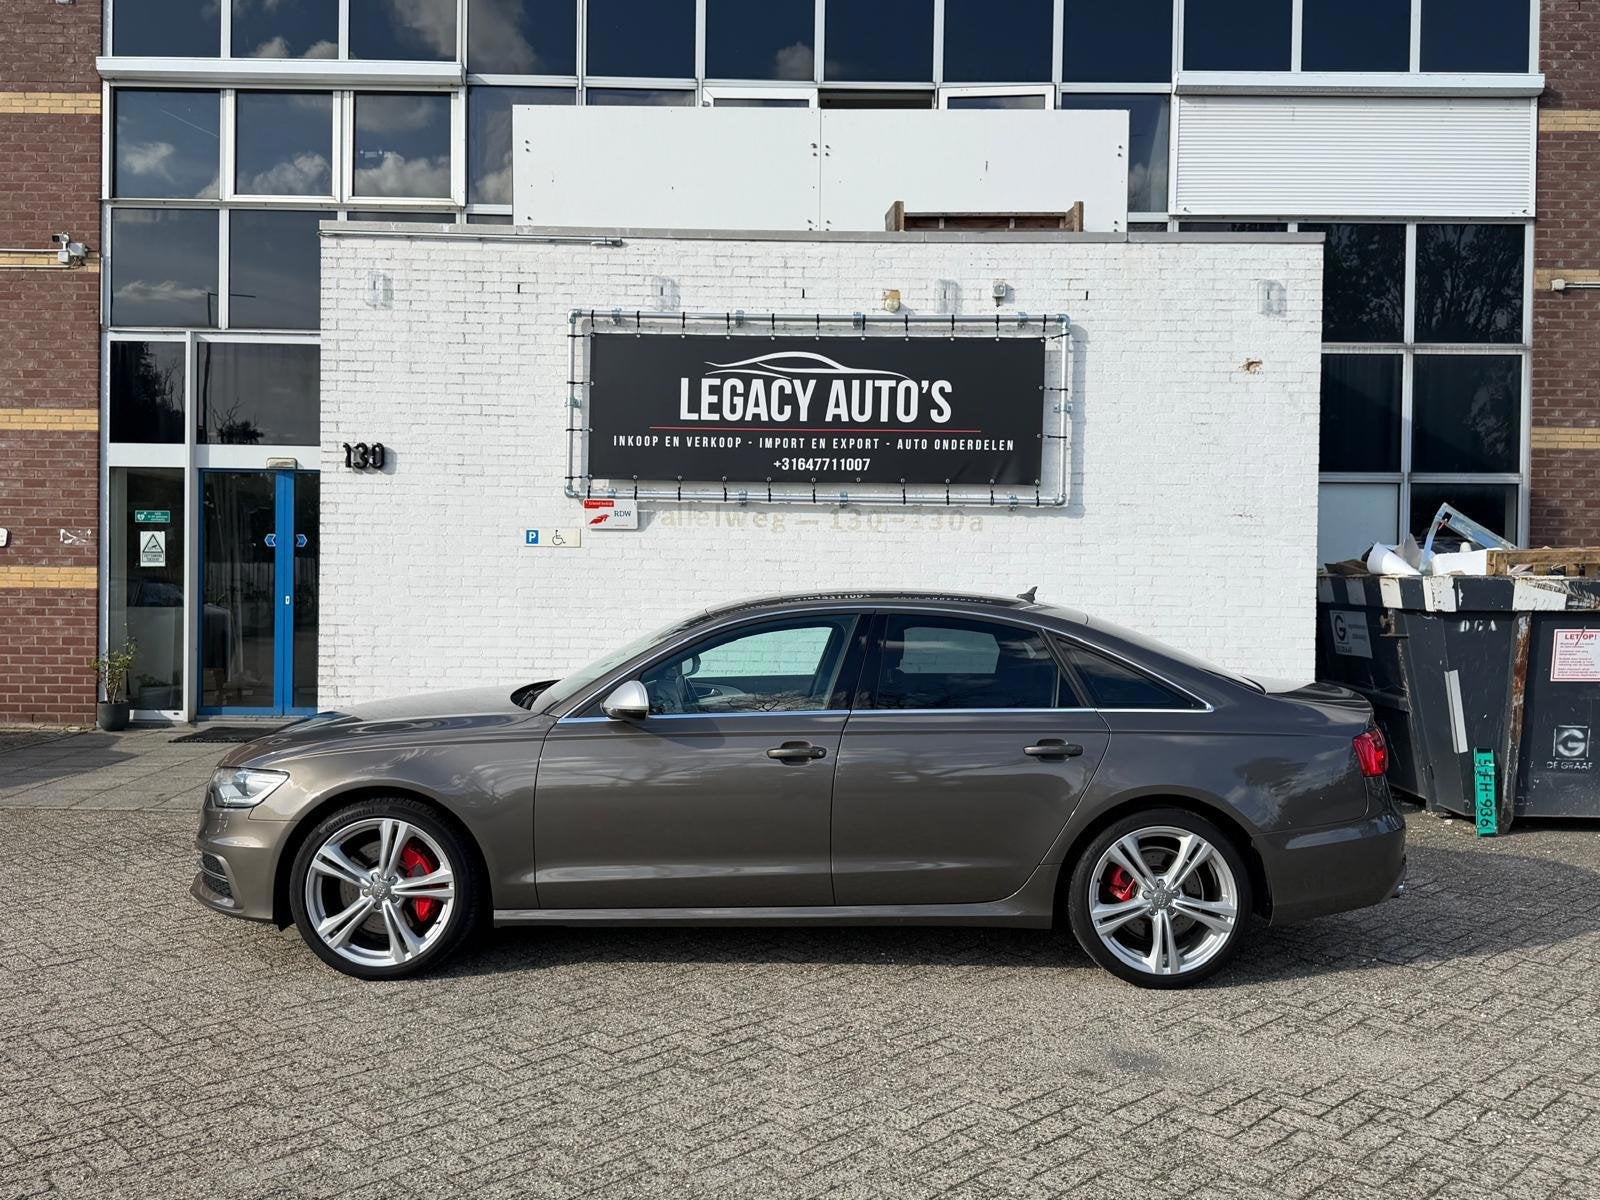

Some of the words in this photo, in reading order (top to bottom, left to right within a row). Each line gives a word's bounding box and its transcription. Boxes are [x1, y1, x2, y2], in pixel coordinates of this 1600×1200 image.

[680, 378, 817, 422] LEGACY
[825, 379, 952, 424] AUTO'S
[613, 434, 659, 447] INKOOP
[665, 435, 680, 448] EN
[686, 436, 742, 449] VERKOOP
[759, 437, 805, 449] IMPORT
[811, 438, 826, 450] EN
[832, 438, 880, 450] EXPORT
[897, 438, 928, 451] AUTO
[934, 439, 1014, 451] ONDERDELEN
[343, 442, 385, 469] 130
[773, 457, 871, 472] +31647711007
[528, 531, 537, 543] P
